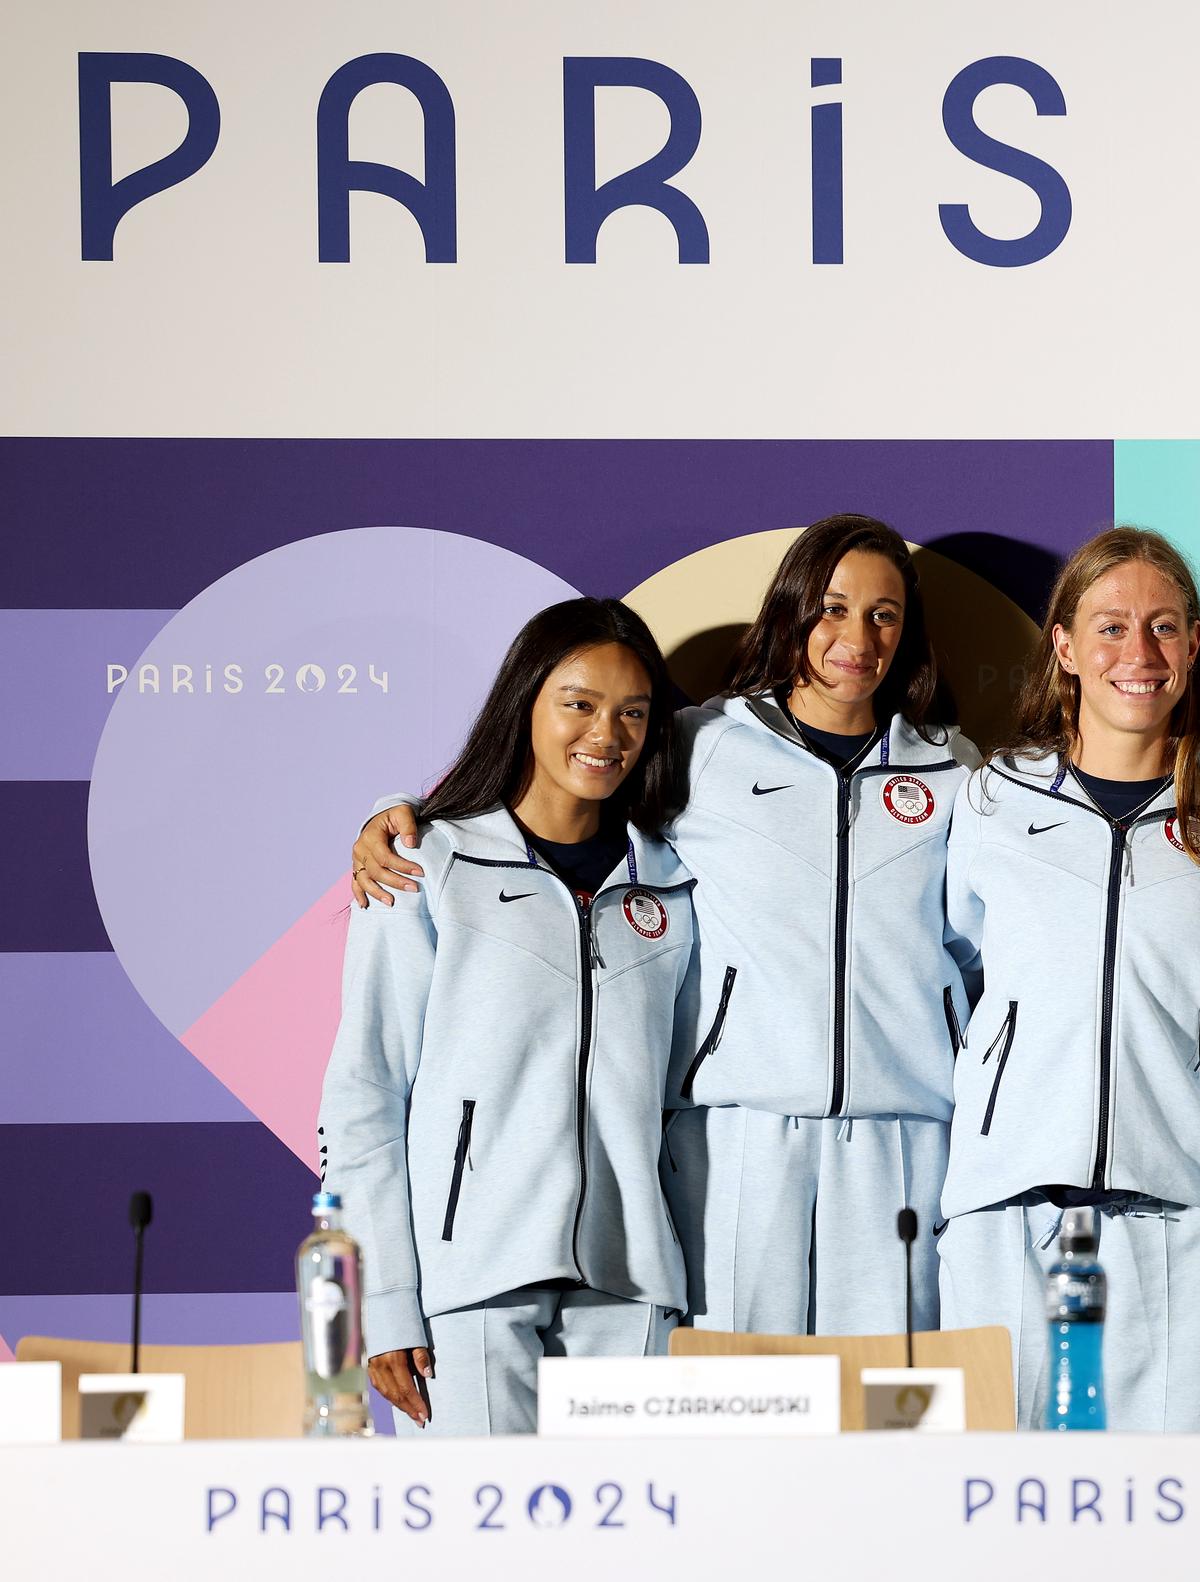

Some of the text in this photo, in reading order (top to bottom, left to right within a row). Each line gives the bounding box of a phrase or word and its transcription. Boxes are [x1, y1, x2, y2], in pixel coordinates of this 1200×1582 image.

[265, 662, 390, 695] 2024
[567, 1395, 811, 1416] Jaime CZARKOWSKI
[474, 1482, 678, 1529] 2024
